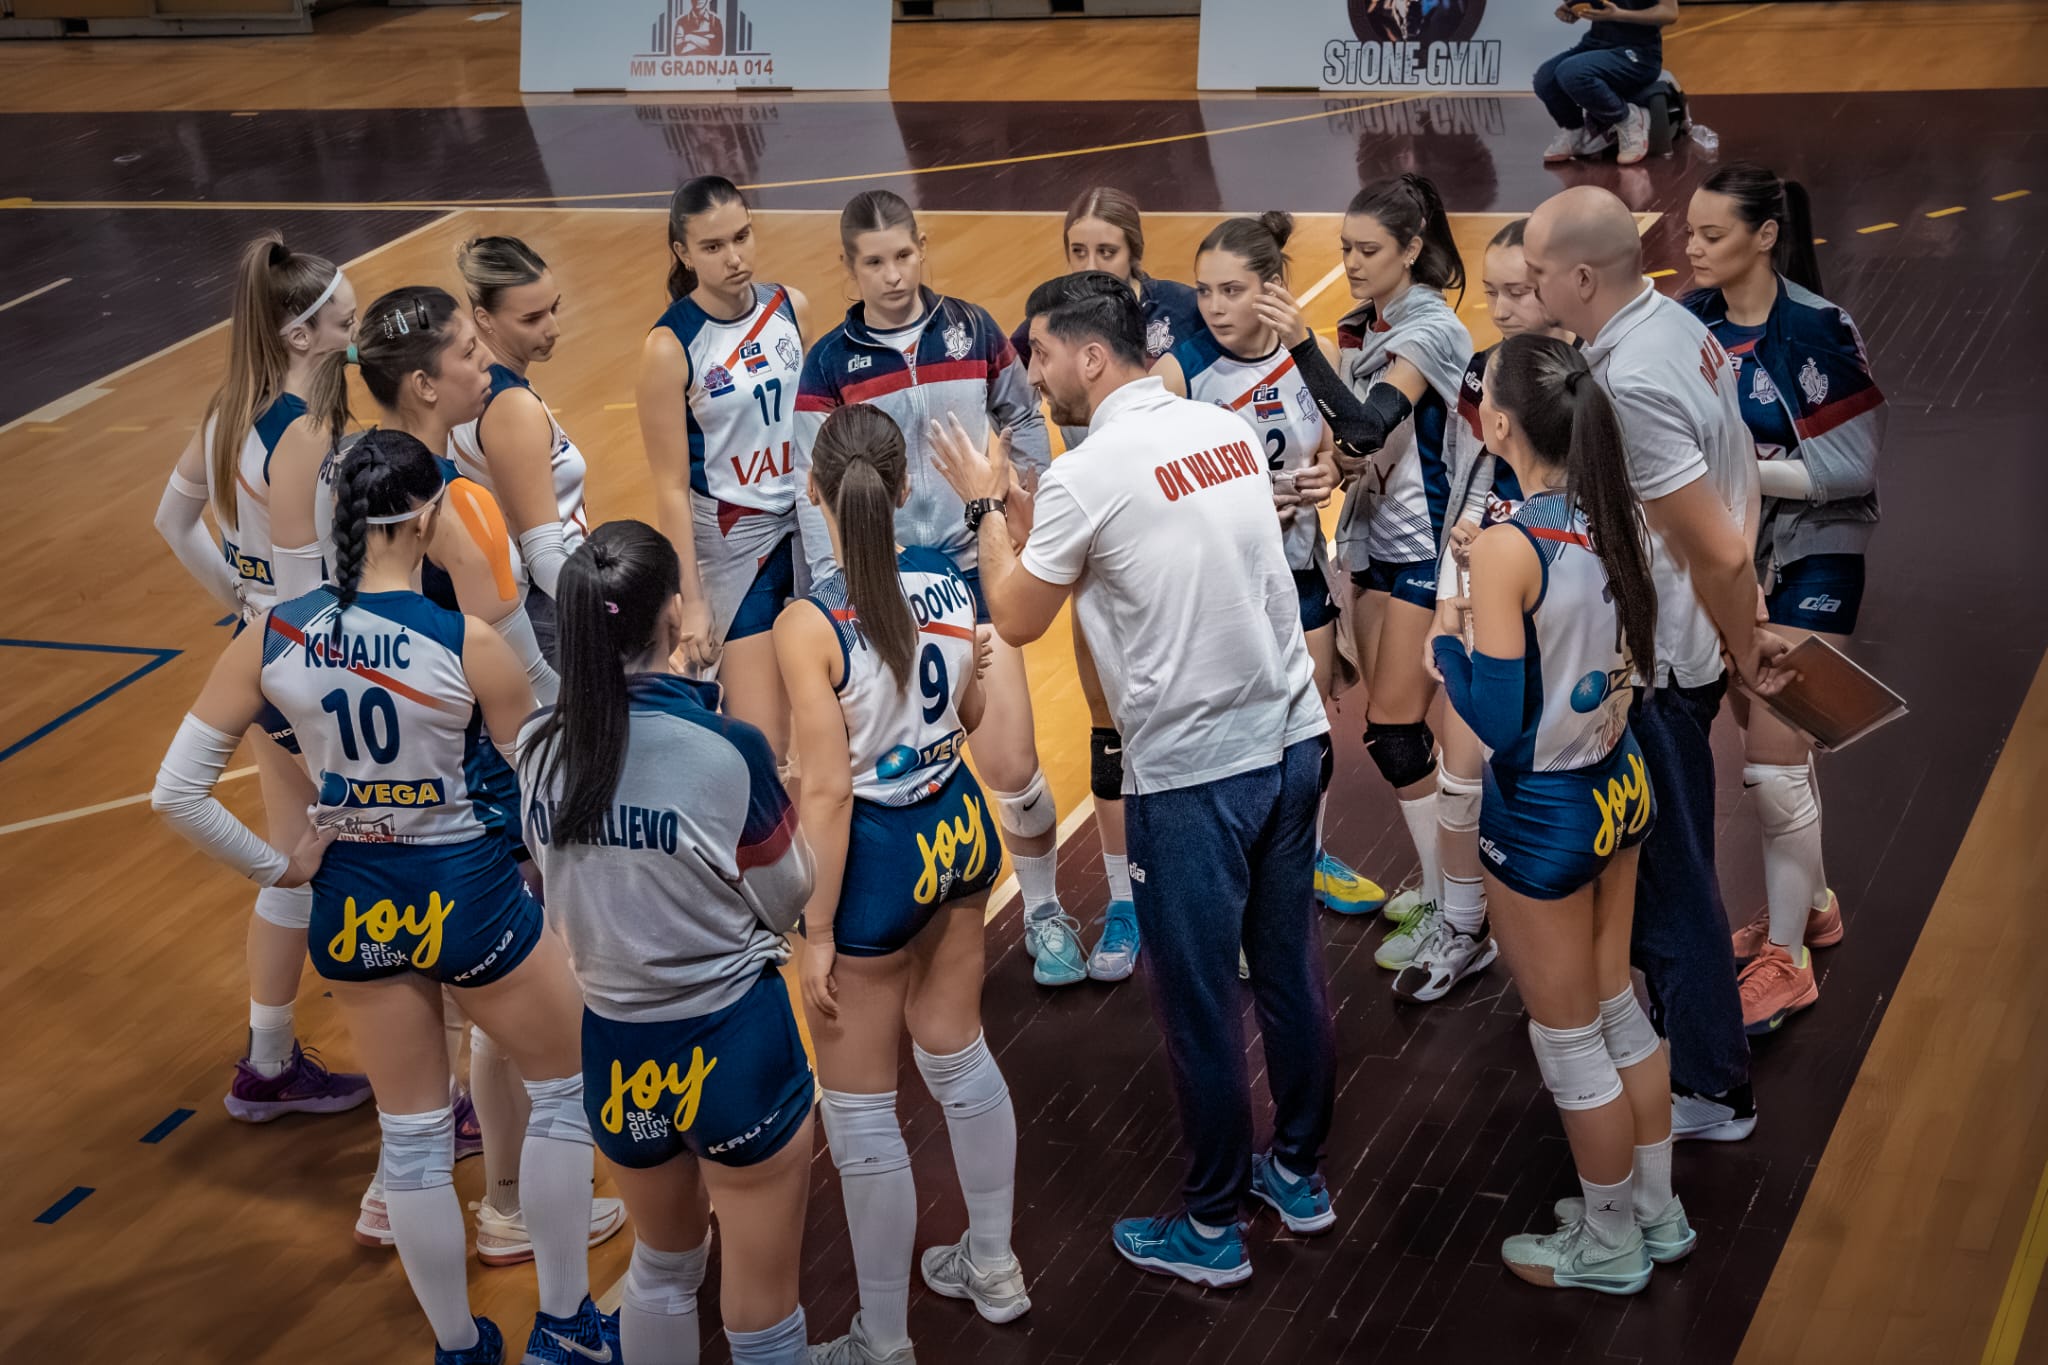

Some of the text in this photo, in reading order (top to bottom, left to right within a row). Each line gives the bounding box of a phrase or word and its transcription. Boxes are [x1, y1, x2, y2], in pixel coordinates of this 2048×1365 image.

[630, 59, 774, 76] MM GRADNJA 014
[1323, 39, 1501, 86] STONE GYM
[753, 377, 782, 426] 17
[730, 441, 794, 486] VAL
[1154, 440, 1259, 502] OK VALJEVO
[1265, 428, 1287, 470] 2
[304, 626, 411, 670] KLJAJIĆ
[919, 643, 949, 725] 9
[321, 686, 400, 765] 10
[923, 732, 963, 765] VEG
[351, 782, 441, 805] VEGA
[590, 804, 678, 856] LJEVO
